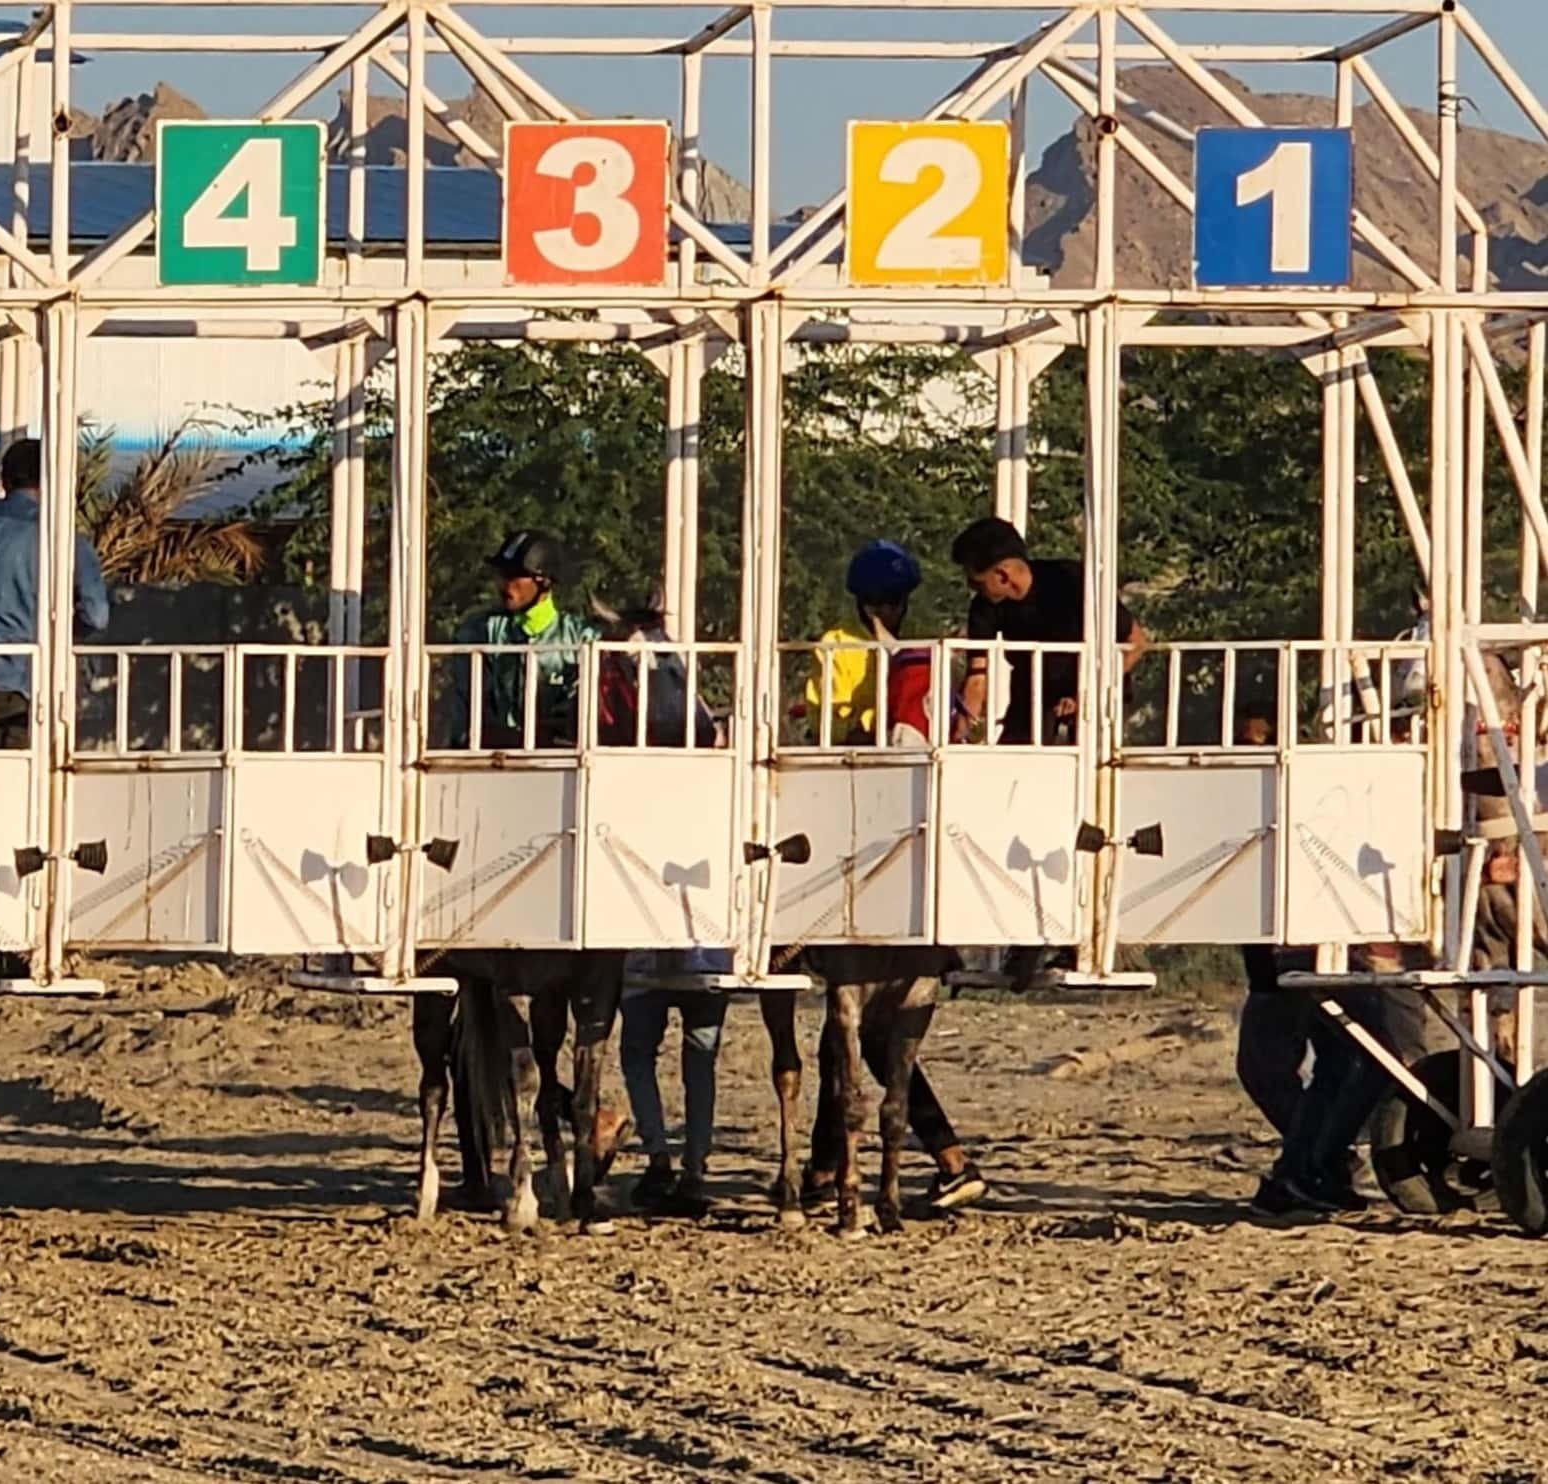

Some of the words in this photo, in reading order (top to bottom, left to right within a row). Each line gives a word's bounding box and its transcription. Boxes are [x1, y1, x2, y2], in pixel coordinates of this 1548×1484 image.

[184, 138, 297, 271] 4
[535, 137, 639, 271] 3
[877, 138, 981, 269] 2
[1236, 142, 1312, 273] 1
